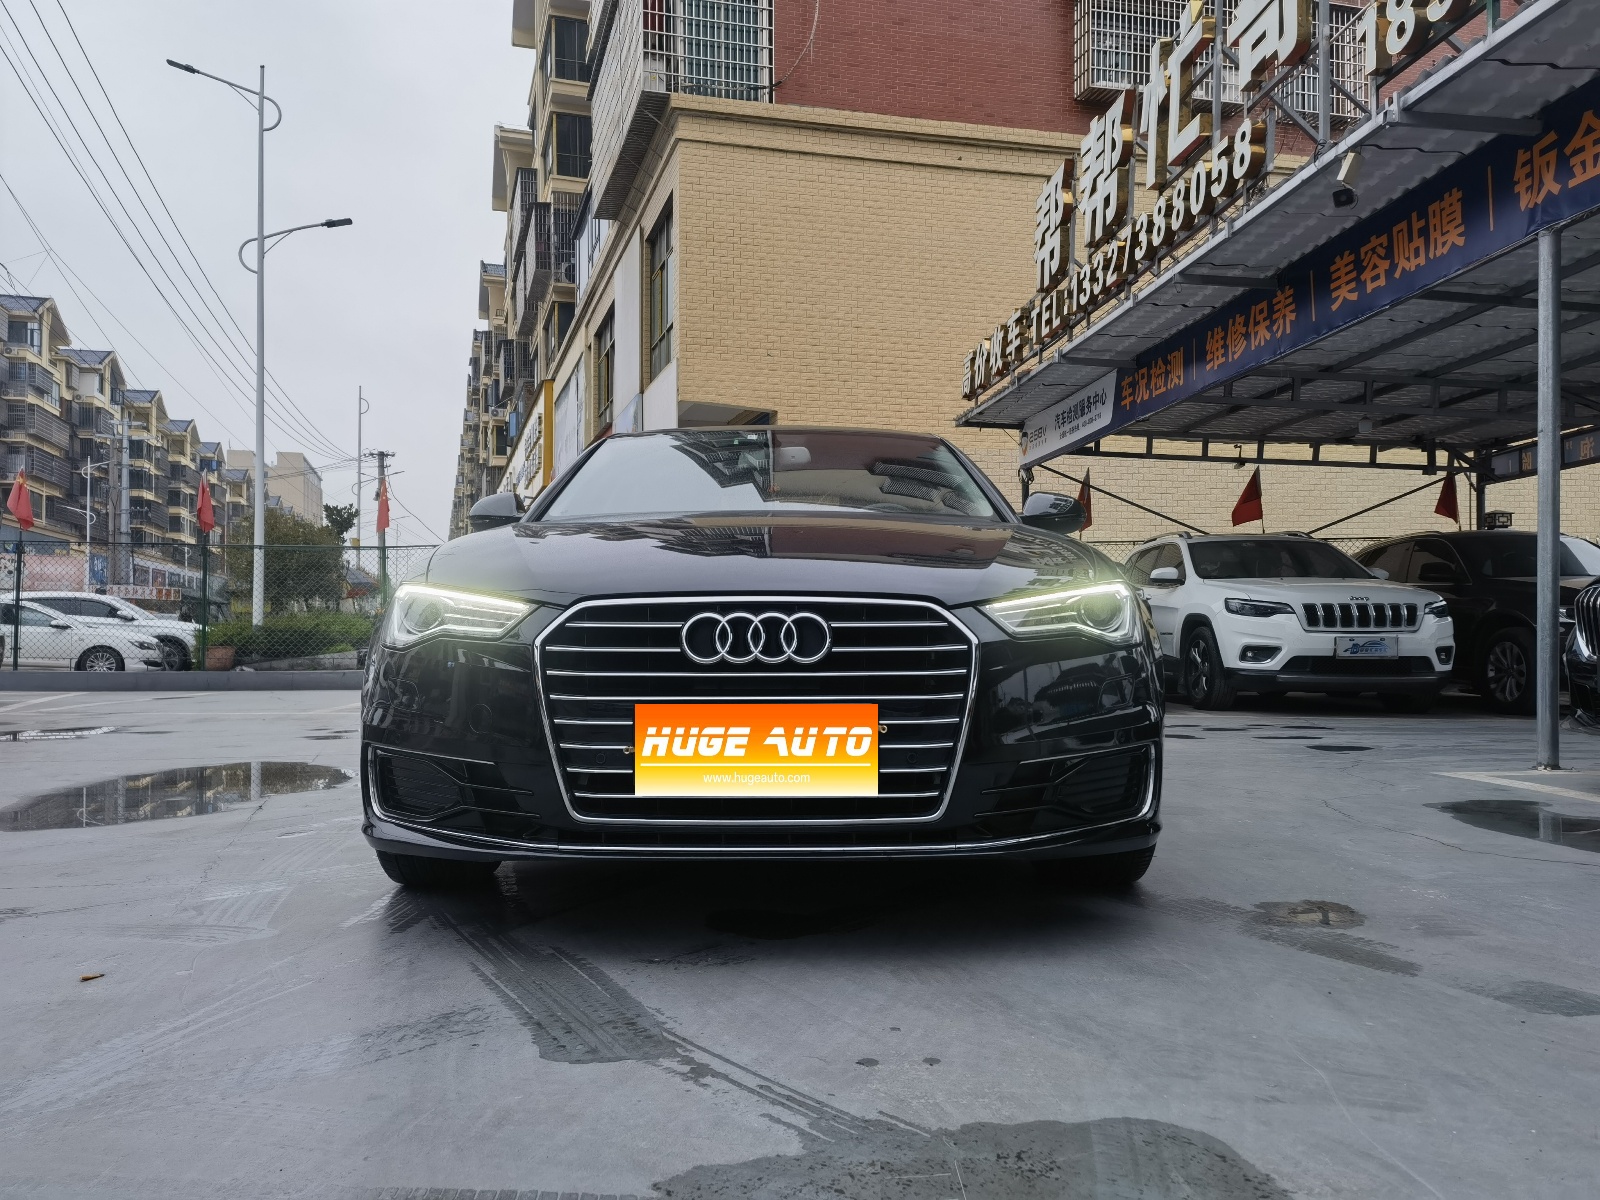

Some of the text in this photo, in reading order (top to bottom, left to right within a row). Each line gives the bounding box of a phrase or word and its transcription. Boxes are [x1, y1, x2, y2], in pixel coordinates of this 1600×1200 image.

[1120, 346, 1185, 411] 车况检测
[1205, 284, 1297, 372] 维修保养
[1329, 187, 1466, 311] 美容贴膜
